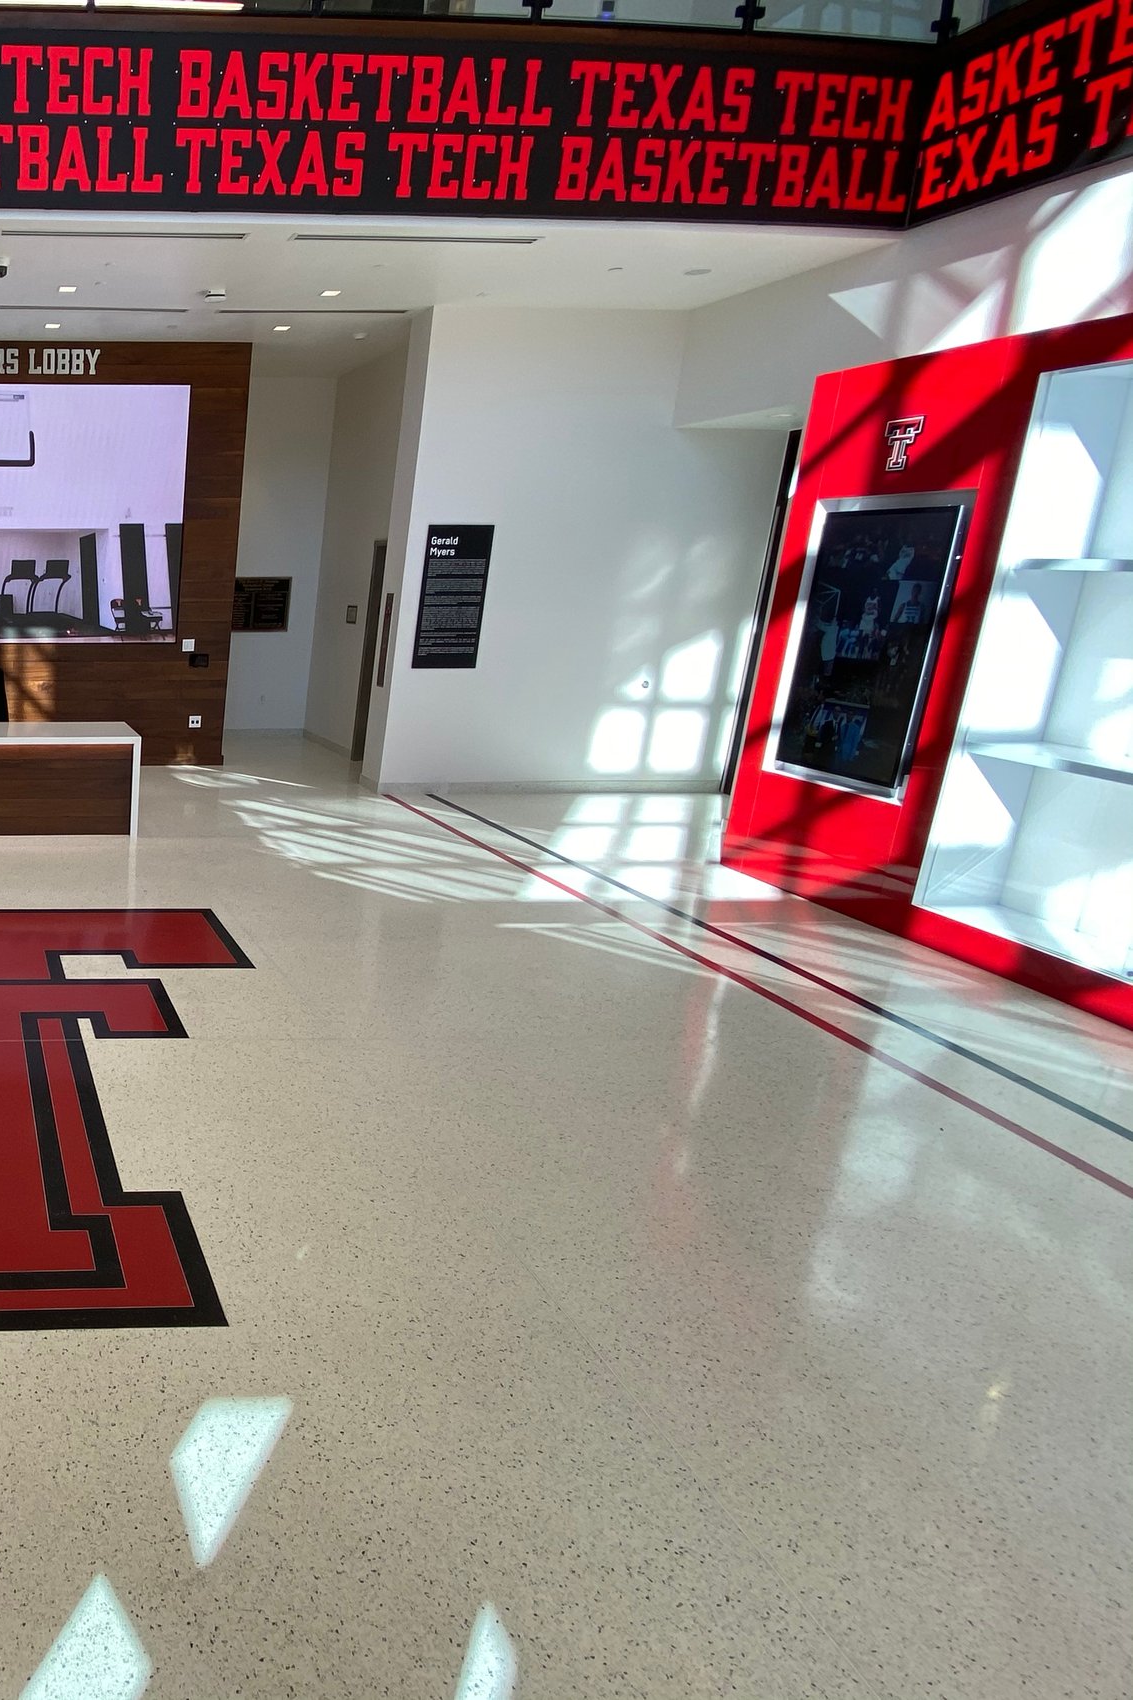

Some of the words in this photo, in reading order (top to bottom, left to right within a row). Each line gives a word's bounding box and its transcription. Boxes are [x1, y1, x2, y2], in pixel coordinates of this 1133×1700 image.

[1, 45, 153, 116] TECH
[177, 50, 551, 126] BASKETBALL
[571, 61, 754, 132] TEXAS
[777, 71, 911, 140] TECH
[176, 128, 366, 196] TEXAS
[388, 133, 533, 200] TECH
[555, 136, 905, 212] BASKETBALL
[28, 349, 101, 375] LOBBY
[429, 547, 456, 558] Myers
[431, 536, 459, 545] Gerald
